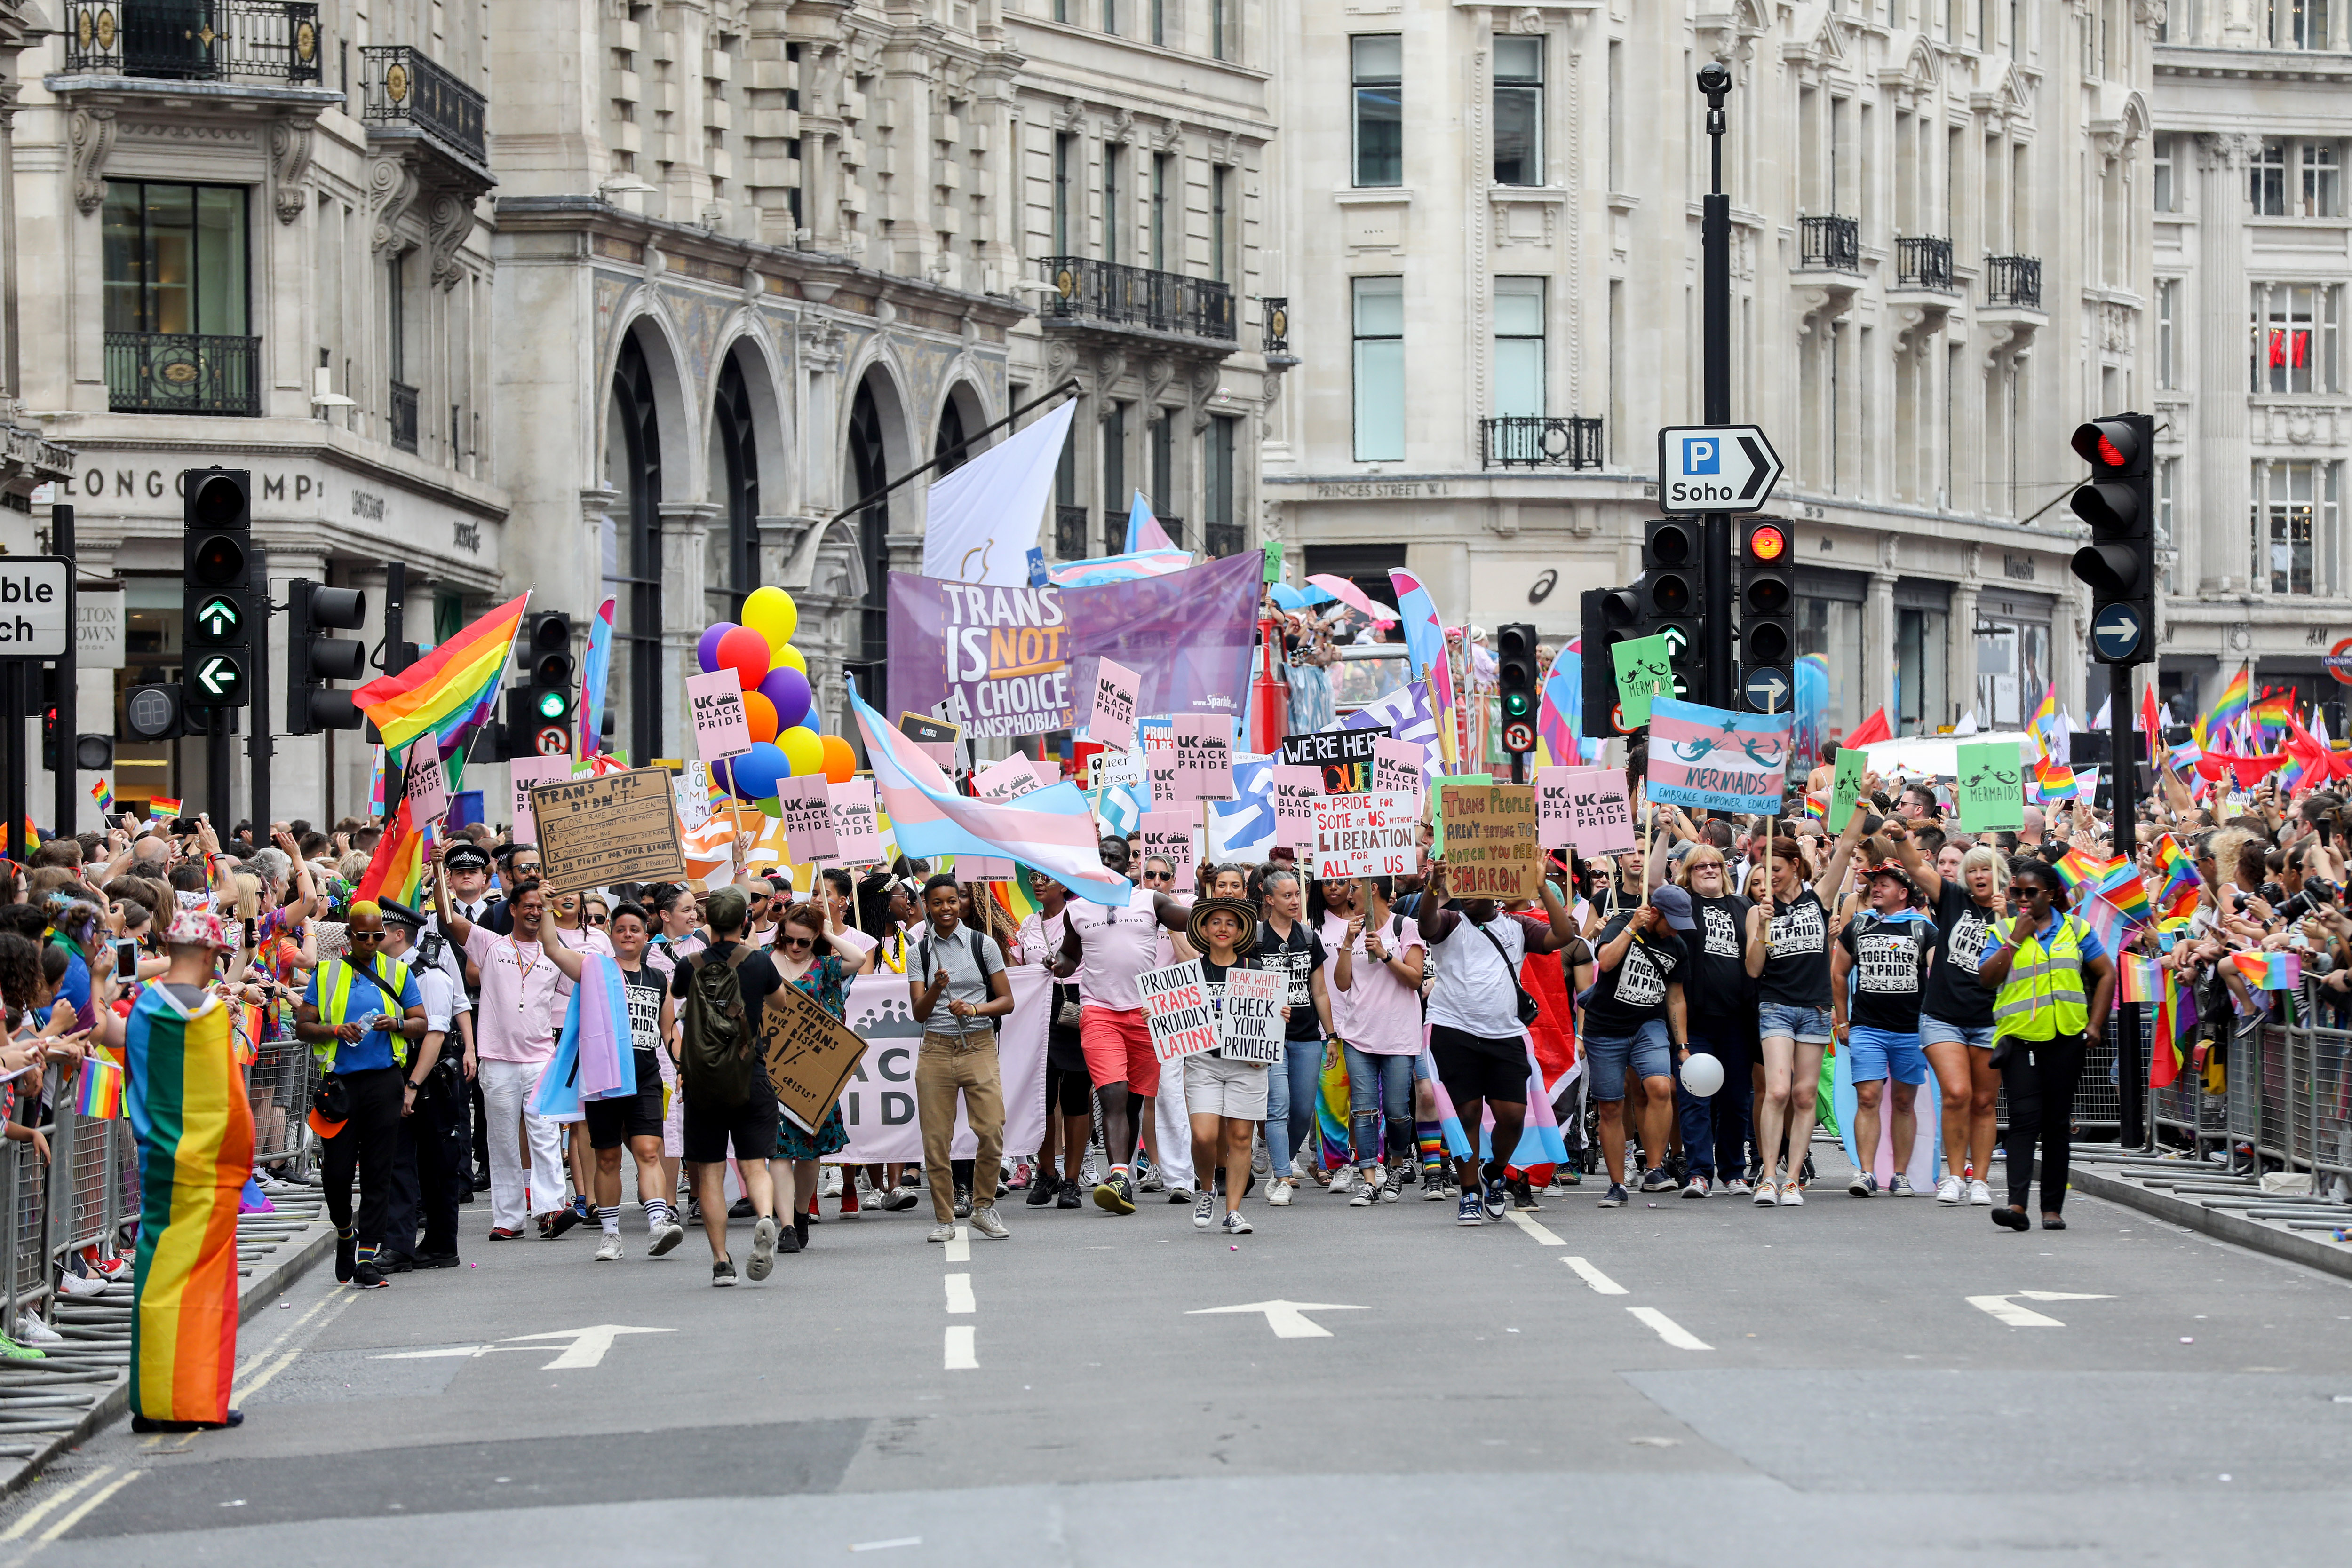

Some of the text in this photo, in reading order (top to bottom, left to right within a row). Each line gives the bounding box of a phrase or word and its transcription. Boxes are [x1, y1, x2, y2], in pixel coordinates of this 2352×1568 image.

[1690, 441, 1713, 471] P
[64, 469, 311, 500] LONGMP
[1318, 484, 1371, 497] PRINCES
[1376, 484, 1420, 497] STREET
[1671, 483, 1732, 501] Soho
[942, 585, 1063, 626] TRANS
[77, 607, 116, 622] LTON
[76, 626, 116, 641] OWN
[947, 626, 1065, 683] IS NOT
[1100, 678, 1115, 696] UK
[694, 695, 715, 709] UK
[954, 684, 972, 718] A
[976, 673, 1070, 717] CHOICE
[1098, 691, 1131, 715] BLACK
[697, 704, 740, 720] BLACK
[1097, 701, 1130, 725] PRIDE
[699, 714, 742, 730] PRIDE
[961, 711, 1061, 739] RANSPHOBIA
[1062, 709, 1073, 723] IS
[1143, 726, 1173, 740] PROU
[1177, 736, 1199, 748] UK
[1283, 734, 1337, 763] WE'RE
[1178, 750, 1227, 759] BLACK
[1092, 755, 1132, 771] Queer
[1178, 760, 1227, 769] PRIDE
[1378, 757, 1397, 771] UK
[408, 768, 438, 791] BLACK
[1094, 773, 1138, 785] Person
[1154, 769, 1175, 781] UK
[1377, 770, 1418, 785] BLACK
[1685, 768, 1767, 796] MERMAIDS
[410, 777, 440, 801] PRIDE
[516, 778, 538, 791] UK
[538, 784, 594, 805] TRANS
[610, 776, 641, 792] PPL
[1278, 784, 1295, 797] UK
[1377, 780, 1418, 795] PRIDE
[1543, 787, 1565, 799] UK
[1575, 793, 1597, 806] UK
[1970, 786, 2020, 802] MERMAIDS
[784, 798, 803, 811] UK
[1279, 798, 1310, 808] BLAC
[1332, 796, 1371, 811] PRIDE
[1380, 798, 1394, 807] FOR
[1442, 788, 1531, 817] TRANS PEOPLE
[1577, 804, 1625, 817] BLACK
[1748, 799, 1779, 809] EDUCATE
[556, 816, 582, 830] CLOSE
[588, 812, 605, 820] RAPE
[611, 804, 635, 816] CRISIS
[638, 799, 667, 809] CENTRES
[787, 809, 828, 822] BLACK
[834, 815, 872, 826] LACK
[1279, 808, 1311, 818] PRID
[1317, 813, 1352, 830] SOME
[1368, 811, 1385, 827] US
[1578, 814, 1627, 828] PRIDE
[559, 829, 580, 840] PUNCH
[591, 818, 617, 831] LESBIANS
[788, 820, 830, 832] PRIDE
[836, 825, 873, 837] RIDE
[1447, 820, 1533, 840] AREN'T TRYING TO
[563, 846, 587, 857] DEPORT
[593, 841, 612, 849] QUEER
[616, 835, 637, 844] ASYLUM
[574, 834, 596, 843] LONDON
[1145, 833, 1164, 844] UK
[1318, 828, 1412, 852] LIBERATION
[547, 865, 558, 873] WE
[563, 863, 573, 871] DID
[577, 855, 602, 866] FIGHT
[624, 845, 644, 855] YOUR
[646, 841, 675, 852] RIGHTS
[1351, 851, 1368, 860] FOR
[1447, 847, 1485, 864] WATCH
[1489, 845, 1510, 860] YOU
[551, 872, 587, 887] PATRIARCHY
[620, 863, 638, 872] SHARED
[646, 857, 675, 868] PROBLEM!
[1322, 855, 1403, 877] ALL OF US
[1771, 924, 1820, 941] IN PRIDE
[1862, 950, 1914, 964] TOGETHER
[1866, 964, 1911, 976] IN PRIDE
[1141, 963, 1198, 995] PROUDLY
[1229, 970, 1251, 984] DEAR
[1254, 974, 1281, 988] WHITE
[1628, 974, 1639, 988] IN
[1227, 984, 1274, 999] /CIS PEOPLE
[1147, 985, 1202, 1016] TRANS
[1229, 997, 1275, 1018] CHECK
[796, 1001, 837, 1031] CRIMES
[1152, 1005, 1209, 1038] PROUDLY
[767, 1011, 788, 1029] HAVE
[789, 1028, 823, 1055] RISEN
[797, 1016, 839, 1050] TRANS
[1233, 1016, 1266, 1037] YOUR
[1158, 1025, 1217, 1060] LATINX
[1224, 1037, 1280, 1061] PRIVILEGE
[783, 1077, 817, 1103] CRISIS!
